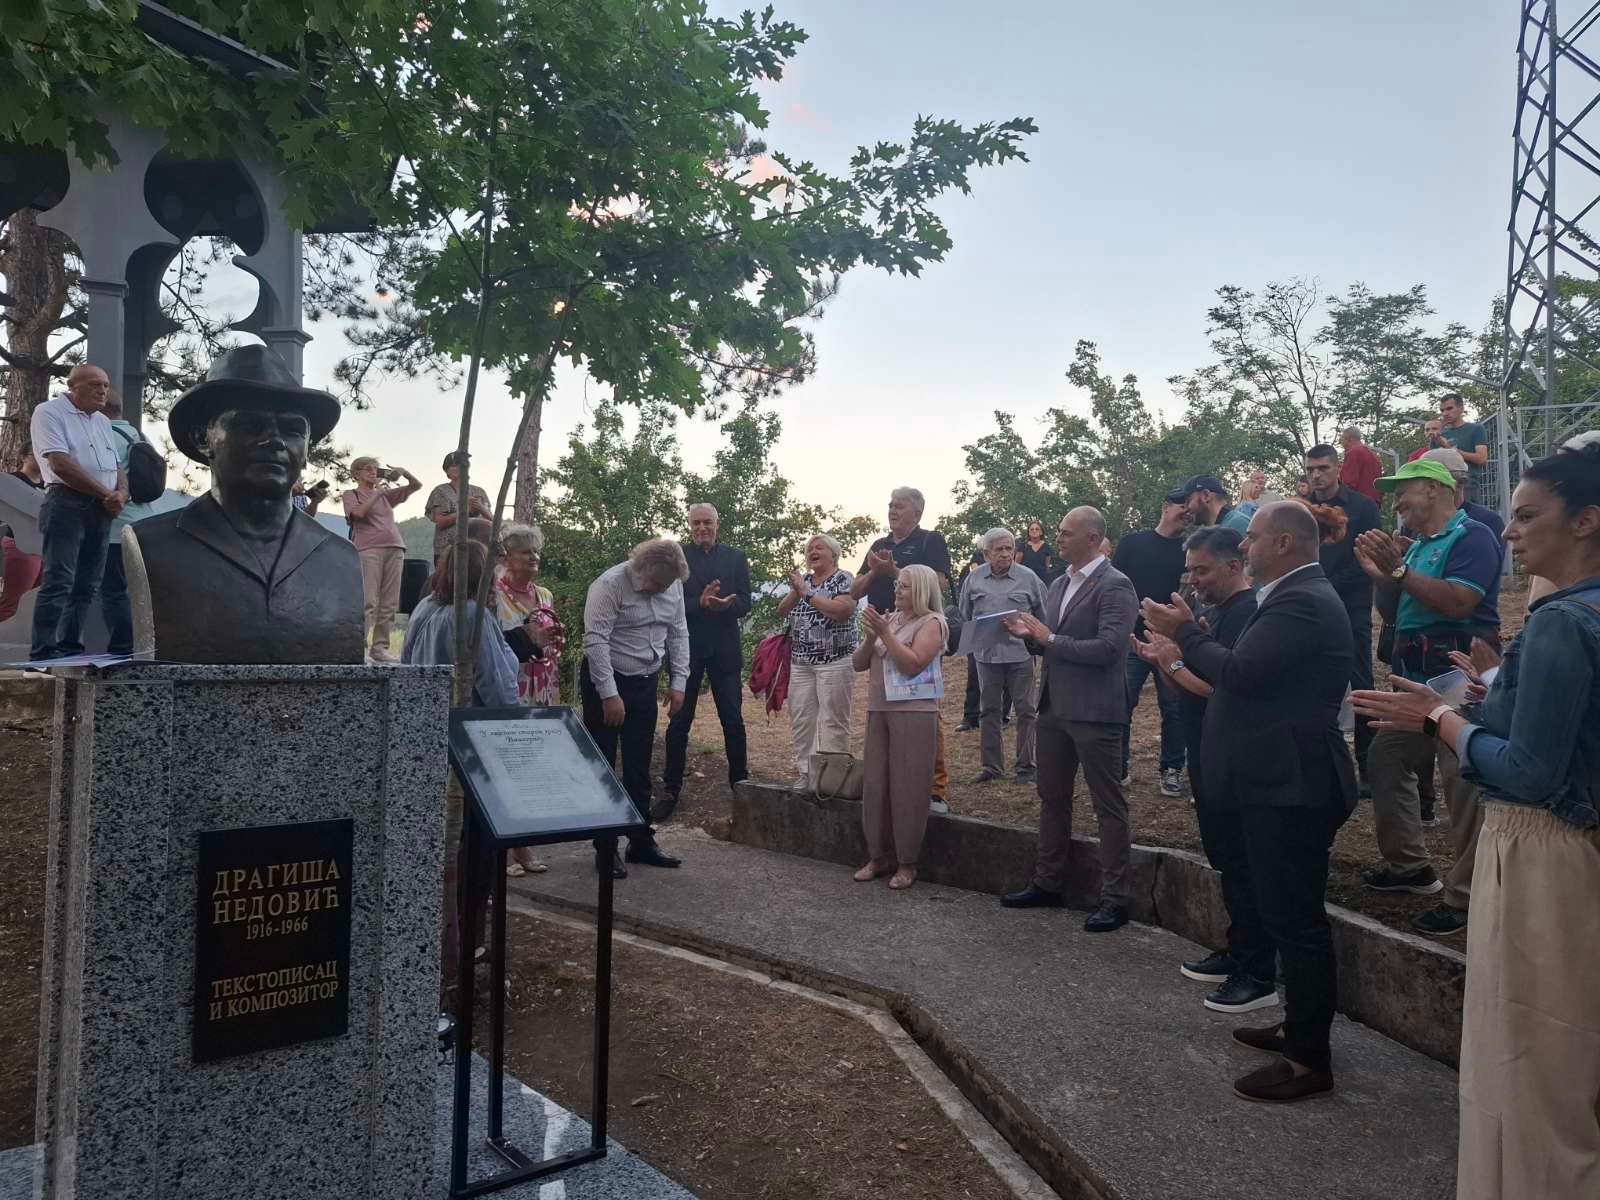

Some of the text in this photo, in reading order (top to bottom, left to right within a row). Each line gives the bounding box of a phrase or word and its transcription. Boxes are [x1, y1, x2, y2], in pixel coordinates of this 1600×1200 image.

[212, 858, 341, 899] ДРАГИША
[213, 886, 339, 924] НЕДОВИЋ
[246, 916, 309, 940] 1916-1966
[211, 960, 338, 998] ТЕКСТОПИСАЦ
[208, 981, 339, 1021] И КОМПОЗИТОР
